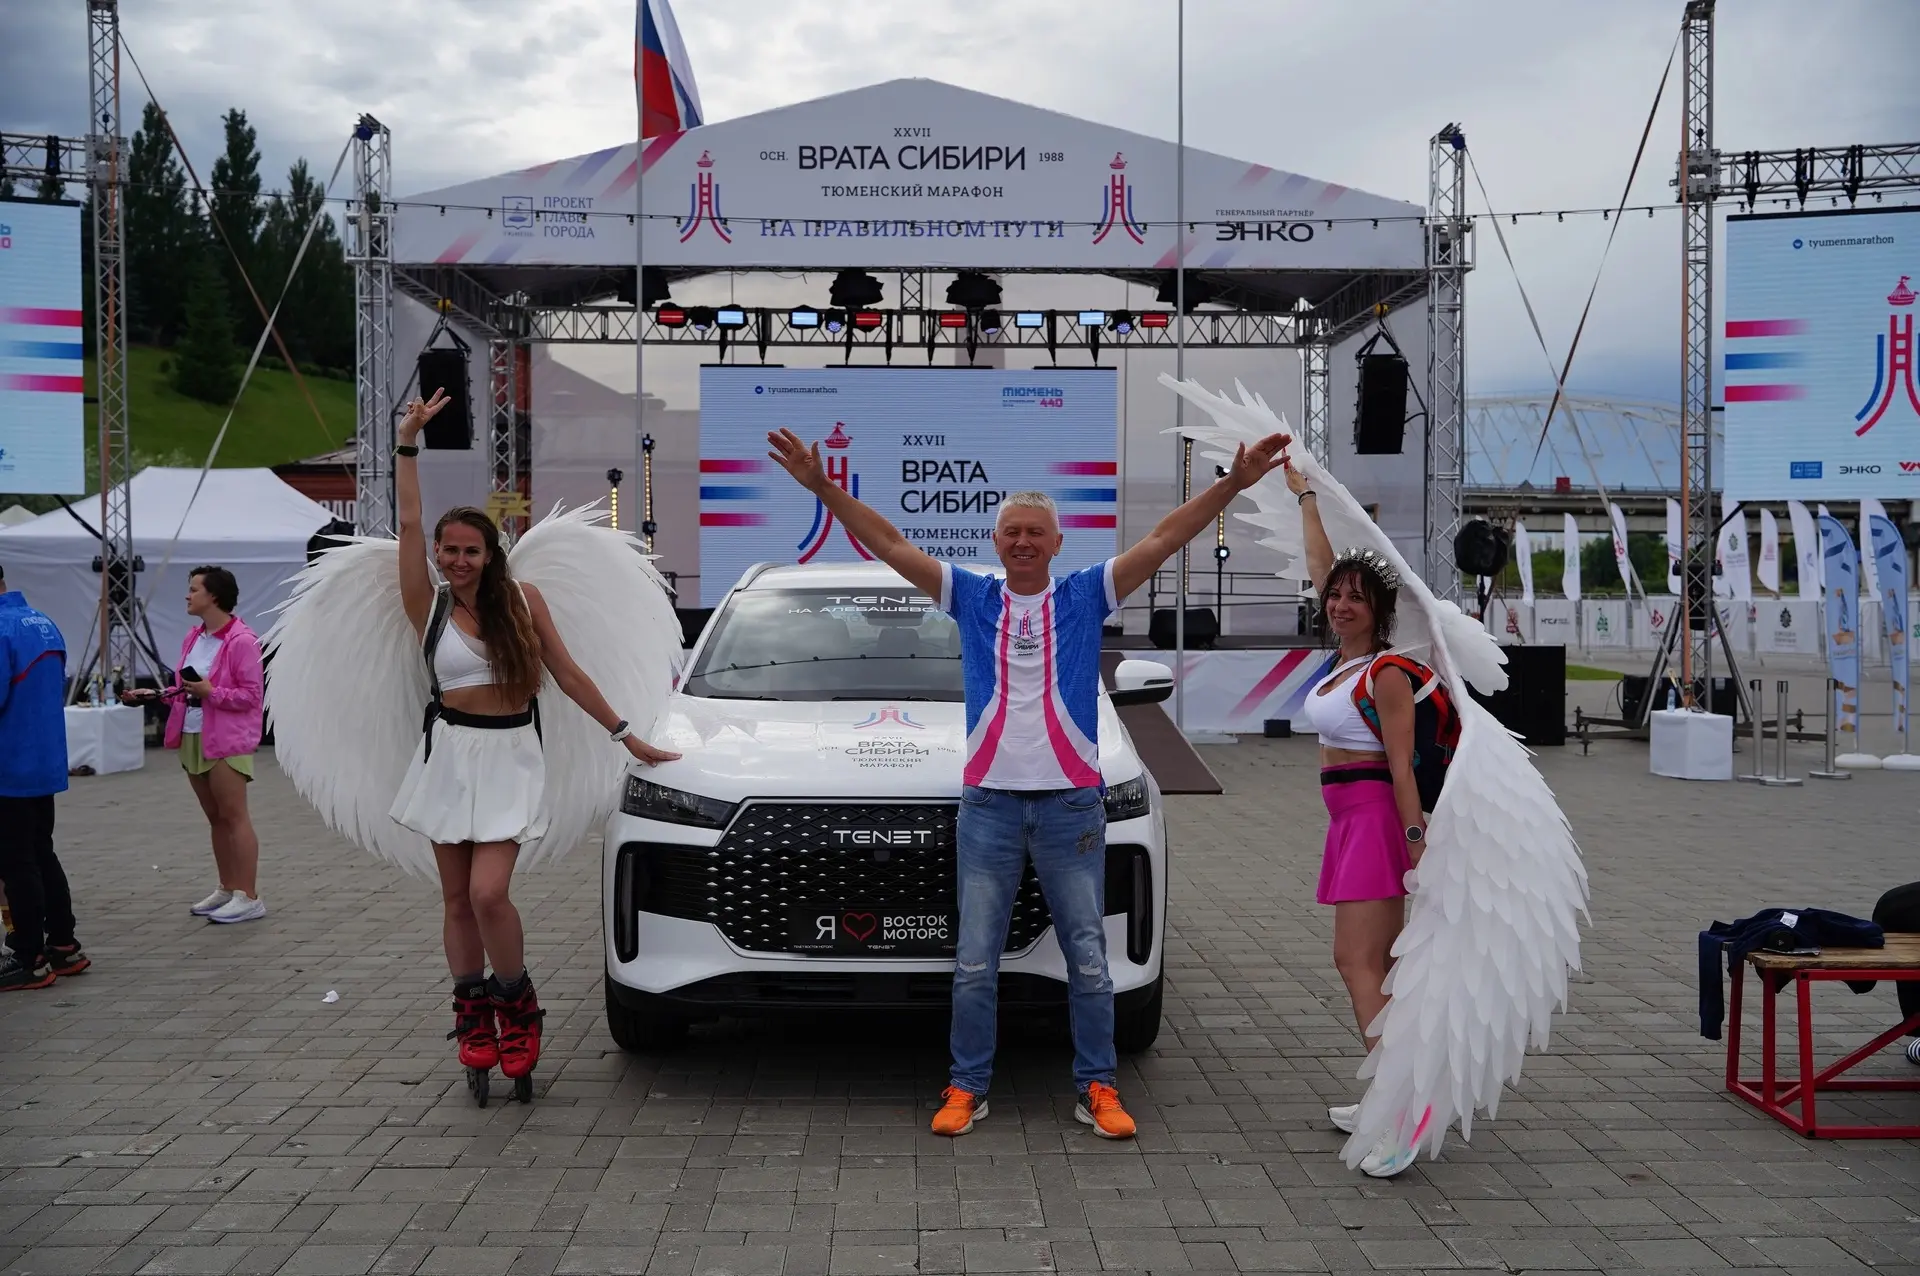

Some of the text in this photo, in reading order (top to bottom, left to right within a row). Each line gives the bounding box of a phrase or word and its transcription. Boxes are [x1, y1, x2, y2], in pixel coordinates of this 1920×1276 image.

[894, 128, 931, 138] XXVII
[760, 145, 1064, 170] ОСН. ВРАТА СИБИРИ 1988
[821, 184, 1003, 198] ТЮМЕНСКИЙ МАРАФОН
[543, 196, 594, 209] ПРОЕКТ
[543, 226, 595, 238] ГОРОДА
[760, 219, 1065, 238] НА ПРАВИЛЬНОМ ПУТИ
[1215, 221, 1314, 243] ЭНКО
[1808, 235, 1895, 248] tyumenmarathon
[768, 386, 838, 395] tyumenmarathon
[1039, 398, 1064, 408] 440
[902, 435, 946, 446] XXVII
[902, 461, 988, 483] ВРАТА
[1839, 465, 1881, 475] ЭНКО
[902, 528, 995, 539] ТЮМЕНСКИ
[833, 830, 932, 844] TENET
[815, 916, 836, 940] Я
[883, 915, 948, 928] ВОСТОК
[883, 928, 948, 940] МОТОРС
